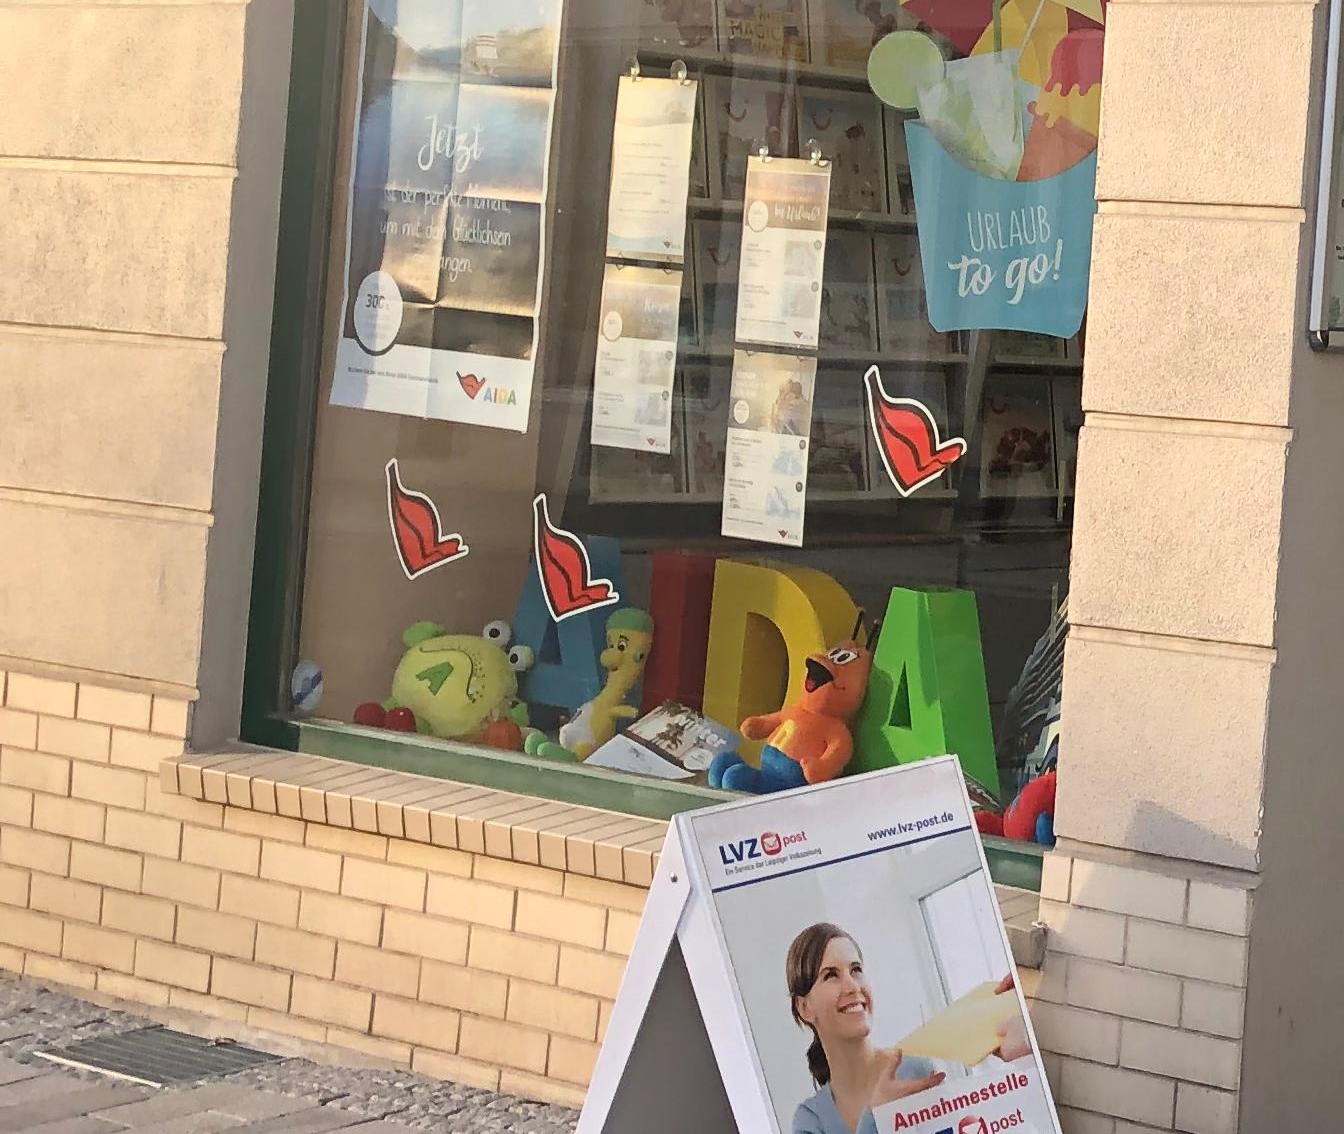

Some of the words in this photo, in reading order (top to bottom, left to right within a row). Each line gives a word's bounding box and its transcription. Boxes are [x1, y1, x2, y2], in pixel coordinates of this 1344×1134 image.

[418, 114, 483, 173] Jetzt
[968, 204, 1050, 252] URLAUB
[948, 253, 995, 298] to
[1005, 239, 1063, 306] go!
[484, 386, 516, 405] AIDA
[867, 812, 954, 842] www.lvz-post.de
[720, 838, 761, 865] LVZ
[783, 831, 807, 847] post
[894, 1073, 1029, 1132] Annahmestelle
[990, 1108, 1025, 1134] post
